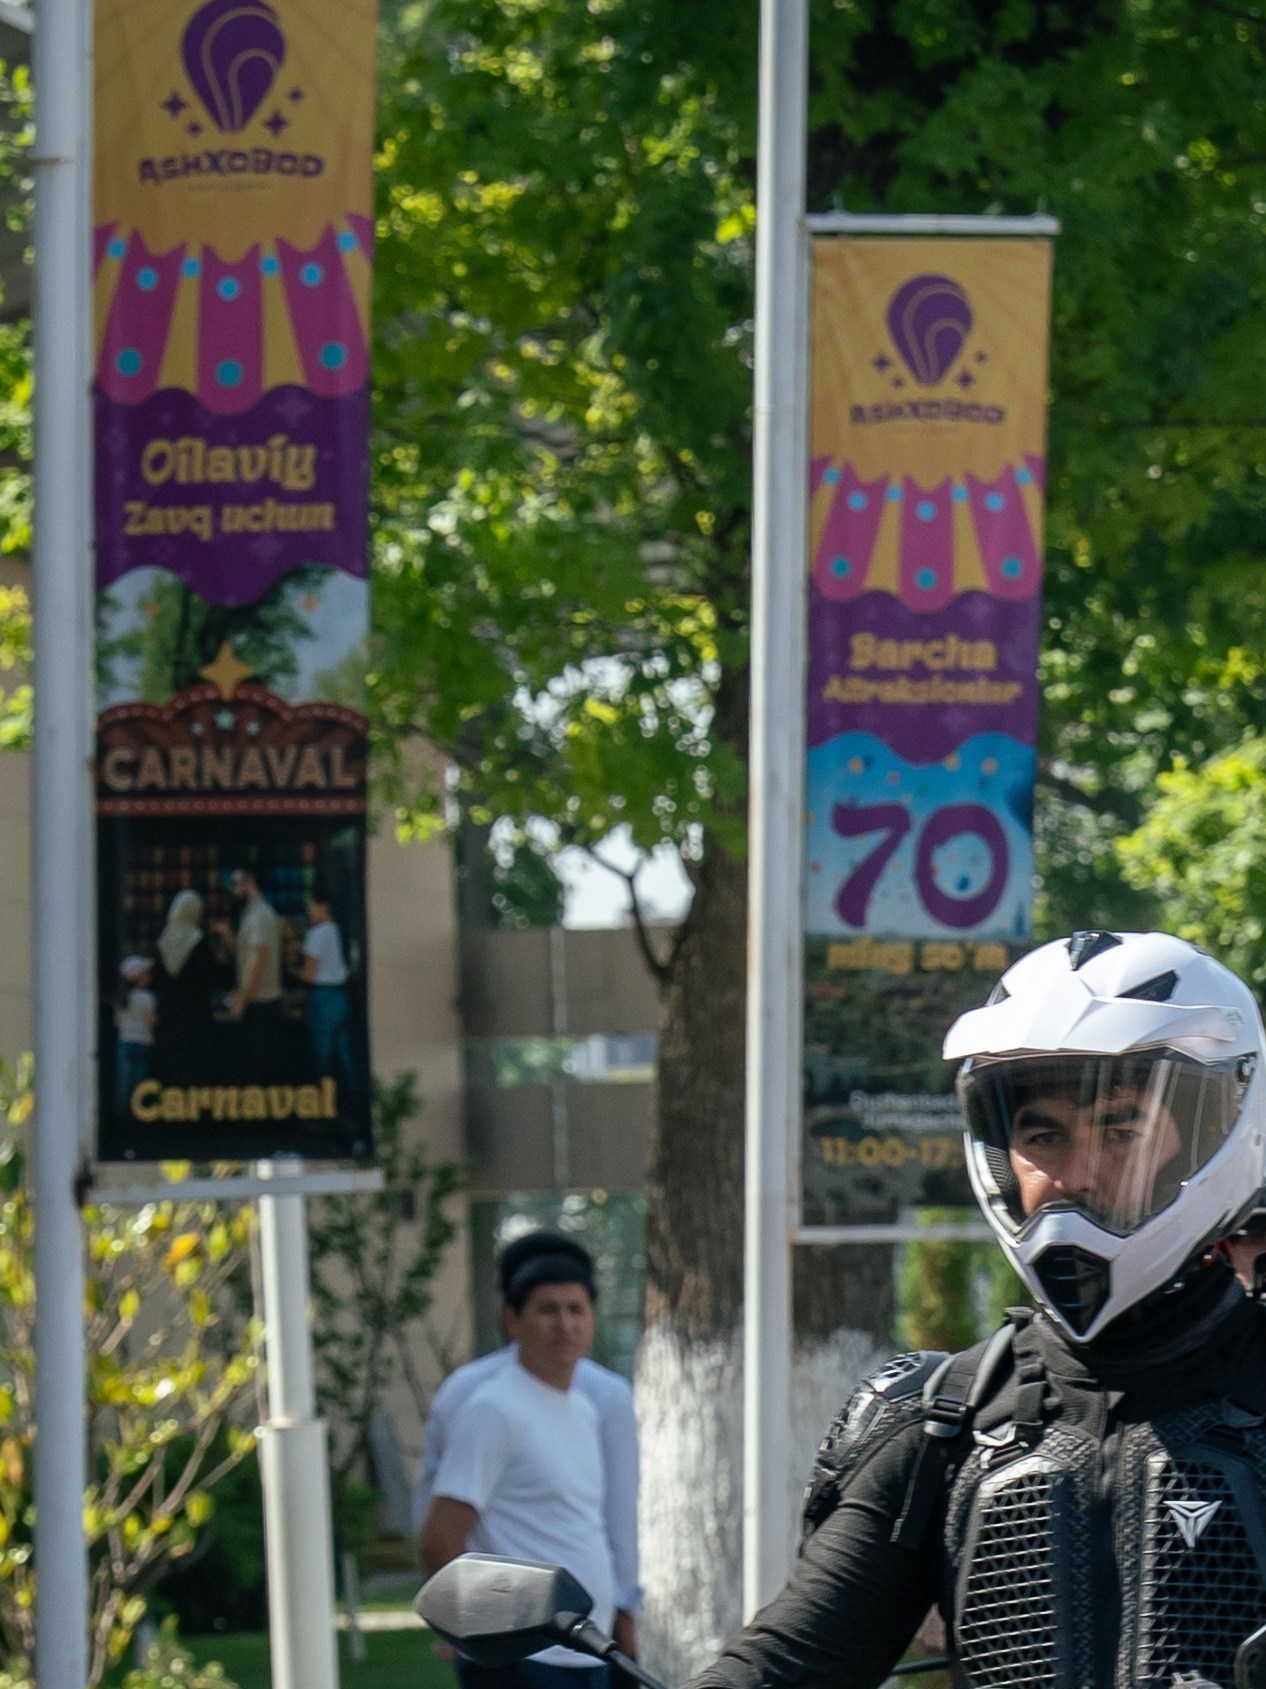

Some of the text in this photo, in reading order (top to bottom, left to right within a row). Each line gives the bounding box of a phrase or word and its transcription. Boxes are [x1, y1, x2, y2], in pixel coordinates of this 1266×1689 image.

[138, 148, 325, 186] ASHXOBOD
[141, 433, 317, 491] Oilaviy
[102, 744, 358, 792] CARNAVAL
[831, 801, 1010, 929] 70
[130, 1076, 338, 1121] Carnaval
[820, 1135, 966, 1168] 11:00-17:
